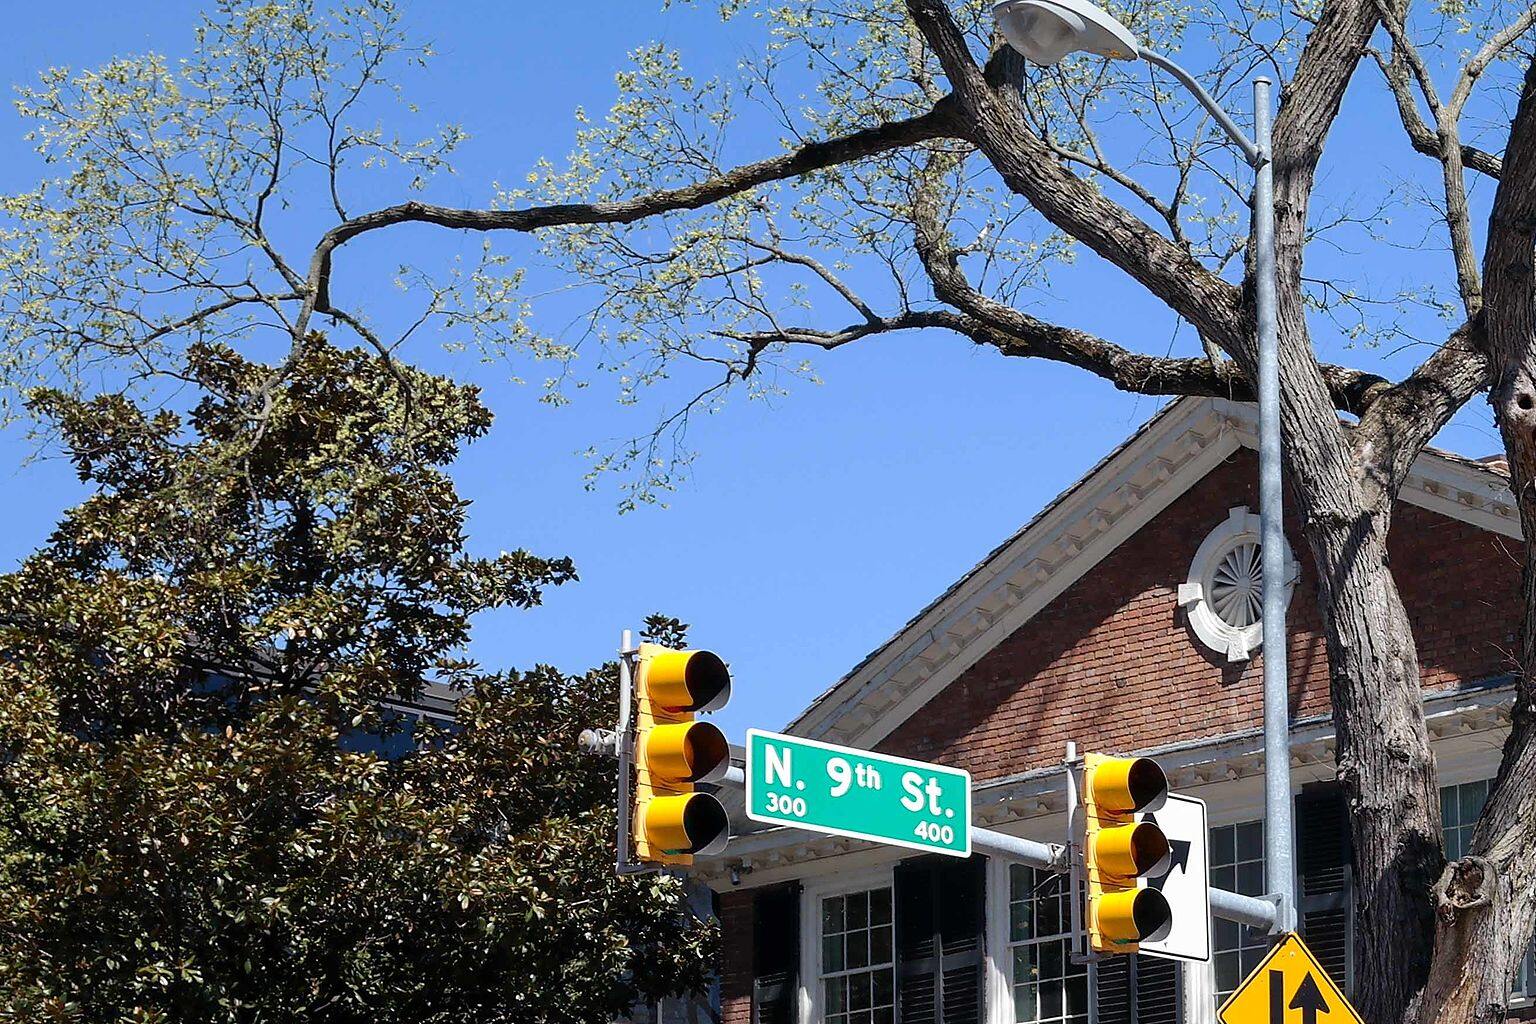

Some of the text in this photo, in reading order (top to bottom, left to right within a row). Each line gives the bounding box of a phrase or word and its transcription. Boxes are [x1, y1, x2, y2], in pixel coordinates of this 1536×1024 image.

[764, 744, 956, 819] N. 9th St.
[765, 791, 807, 818] 300
[913, 820, 955, 846] 400
